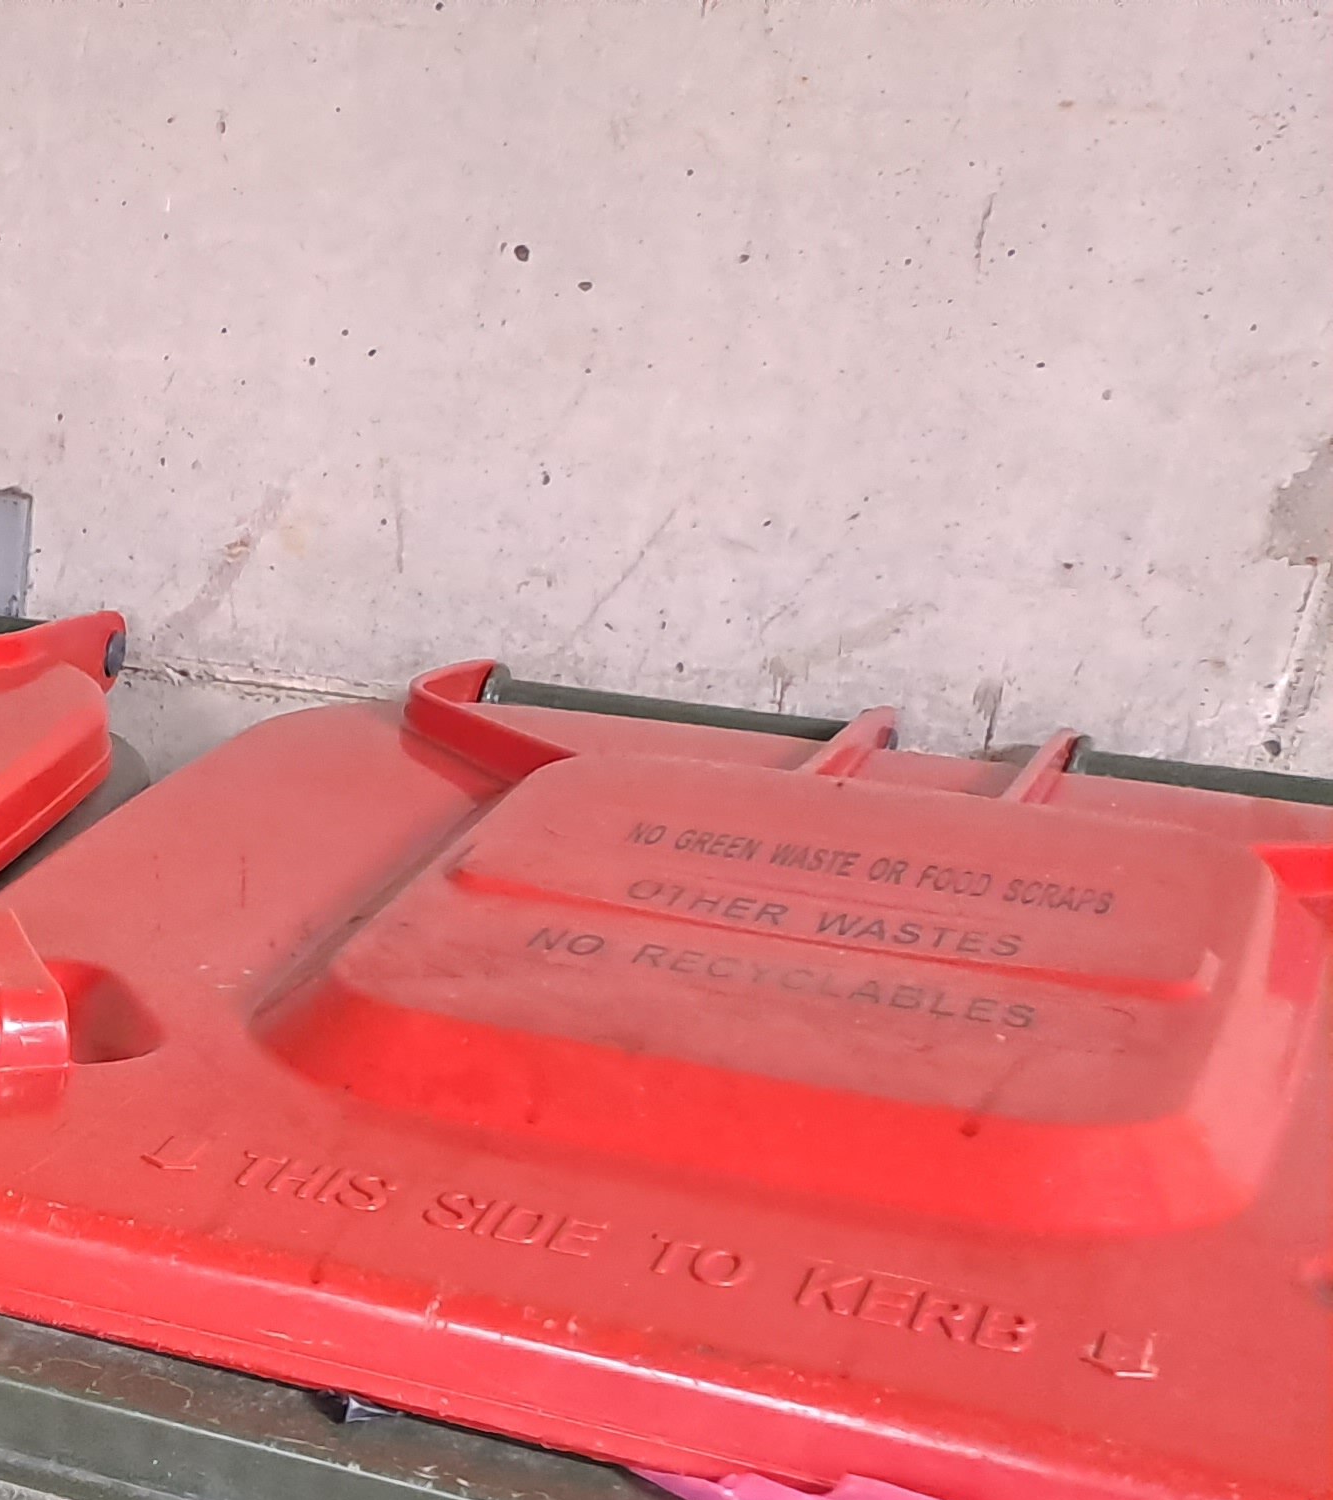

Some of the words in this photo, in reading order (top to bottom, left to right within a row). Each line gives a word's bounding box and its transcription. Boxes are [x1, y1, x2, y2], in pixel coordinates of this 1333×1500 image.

[626, 822, 668, 846] NO
[674, 829, 763, 862] GREEN
[769, 843, 861, 878] WASTE
[868, 857, 909, 885] OR
[916, 865, 992, 897] FOOD
[1002, 878, 1113, 915] SCRAPS
[627, 879, 789, 926] OTHER
[815, 912, 1023, 957] WASTES
[526, 926, 606, 956] NO
[632, 943, 1037, 1029] RECYCLABLES
[235, 1150, 397, 1212] THIS
[422, 1191, 609, 1258] SIDE
[649, 1232, 753, 1288] TO
[793, 1264, 1036, 1353] KERB
